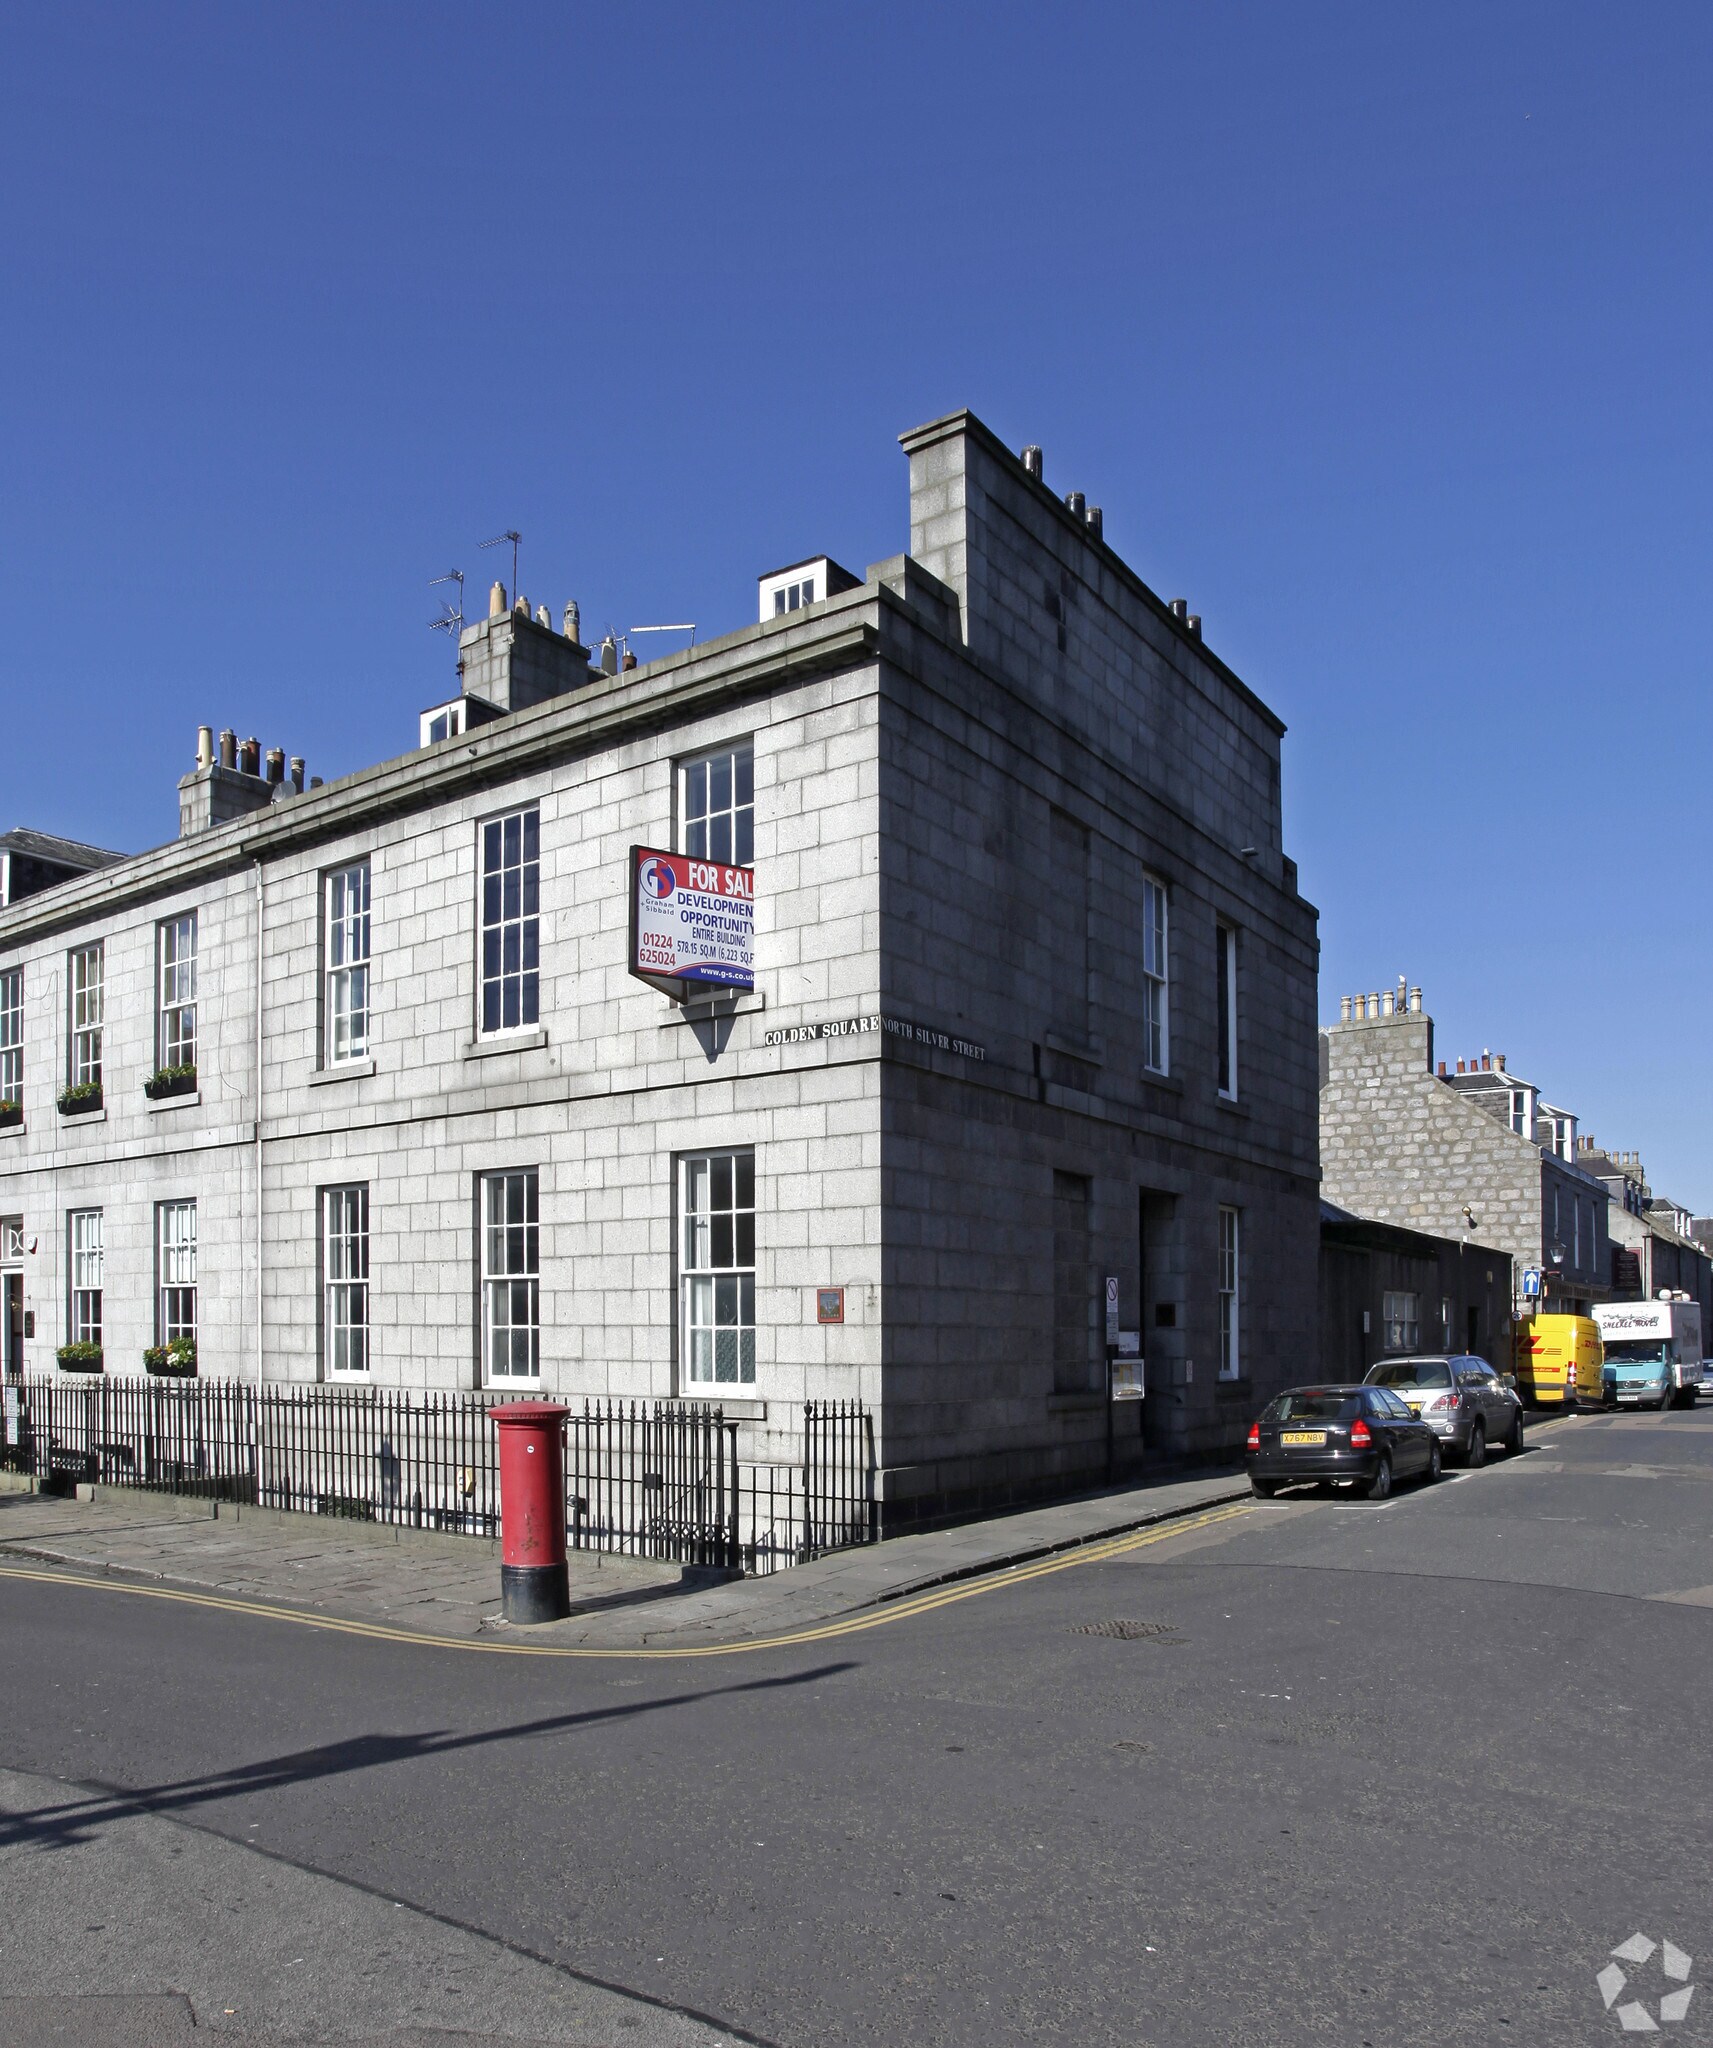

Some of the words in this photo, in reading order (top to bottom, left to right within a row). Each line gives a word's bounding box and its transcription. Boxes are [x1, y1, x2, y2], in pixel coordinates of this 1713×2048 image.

[688, 862, 719, 892] FOR
[724, 869, 754, 898] SAL
[645, 898, 675, 908] Graham
[645, 906, 675, 916] Sibbald
[677, 892, 754, 918] DEVELOPMEN
[643, 932, 673, 949] 01224
[692, 927, 714, 942] ENTIRE
[717, 931, 746, 947] BUILDING
[639, 949, 676, 966] 625024
[677, 941, 697, 955] 578.15
[699, 944, 716, 959] SQ.M
[718, 946, 738, 961] (6,223
[765, 1025, 817, 1046] GOLDEN
[822, 1015, 879, 1038] SQUARE
[882, 1017, 913, 1038] NORTH
[916, 1028, 950, 1050] SILVER
[952, 1039, 985, 1061] STREET
[1284, 1433, 1305, 1442] X767
[1307, 1433, 1324, 1441] NBV
